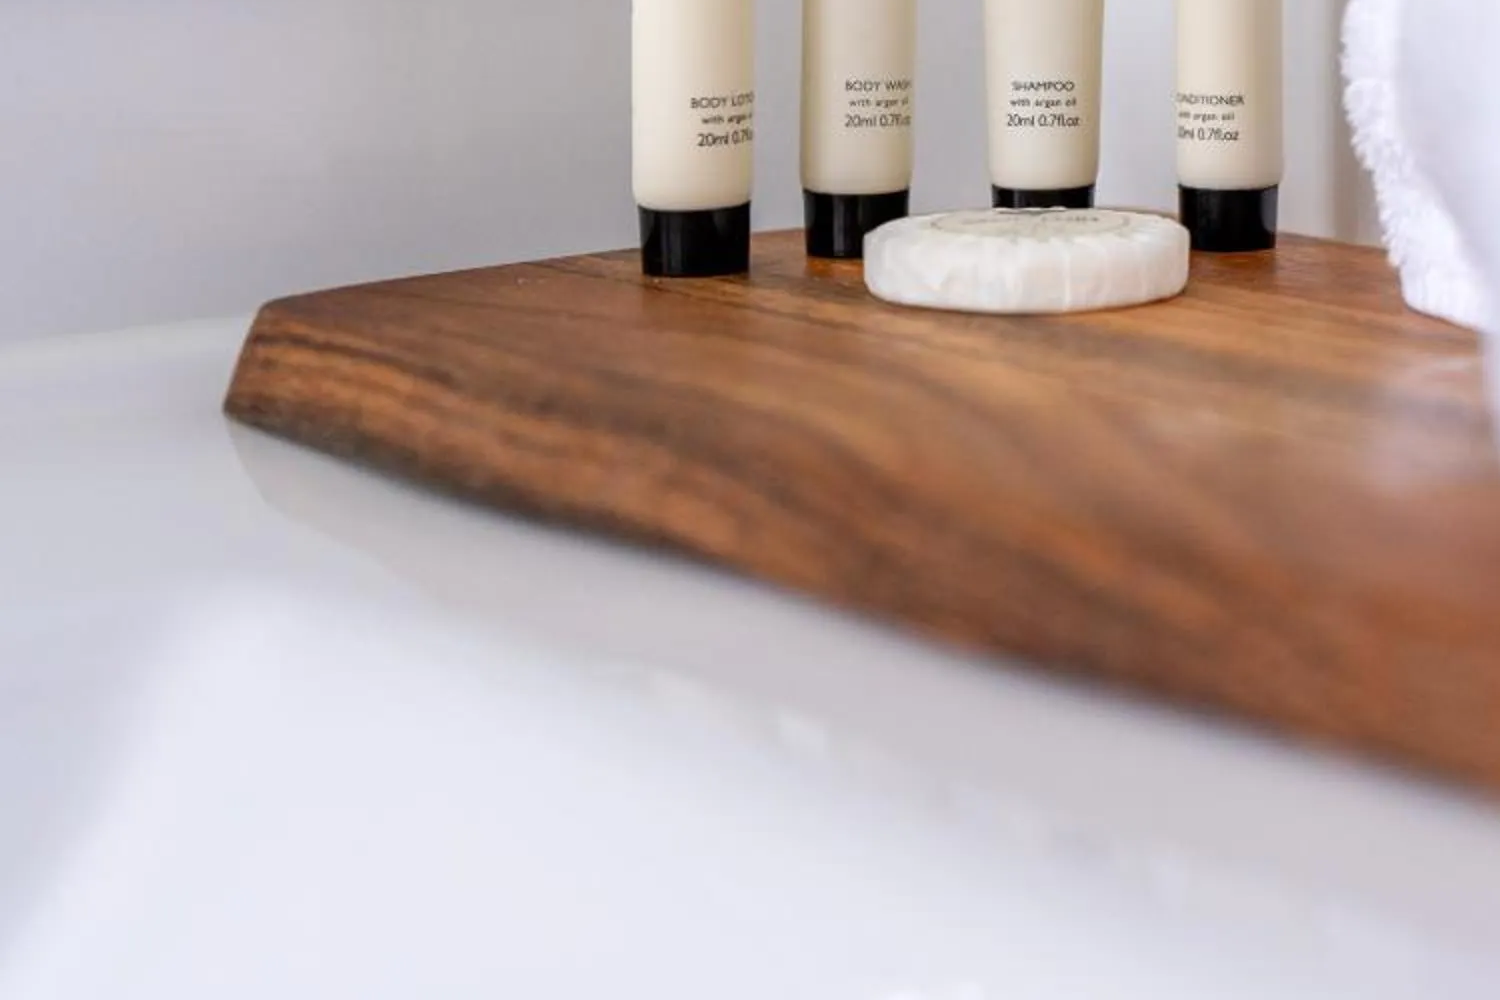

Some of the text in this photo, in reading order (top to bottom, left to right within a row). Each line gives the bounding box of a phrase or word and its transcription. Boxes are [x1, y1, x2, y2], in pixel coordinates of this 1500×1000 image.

[844, 80, 880, 92] BODY
[1011, 81, 1076, 92] SHAMPOO
[690, 97, 727, 109] BODY
[844, 113, 877, 128] 20ml
[1006, 113, 1035, 127] 20ml
[697, 132, 729, 147] 20ml
